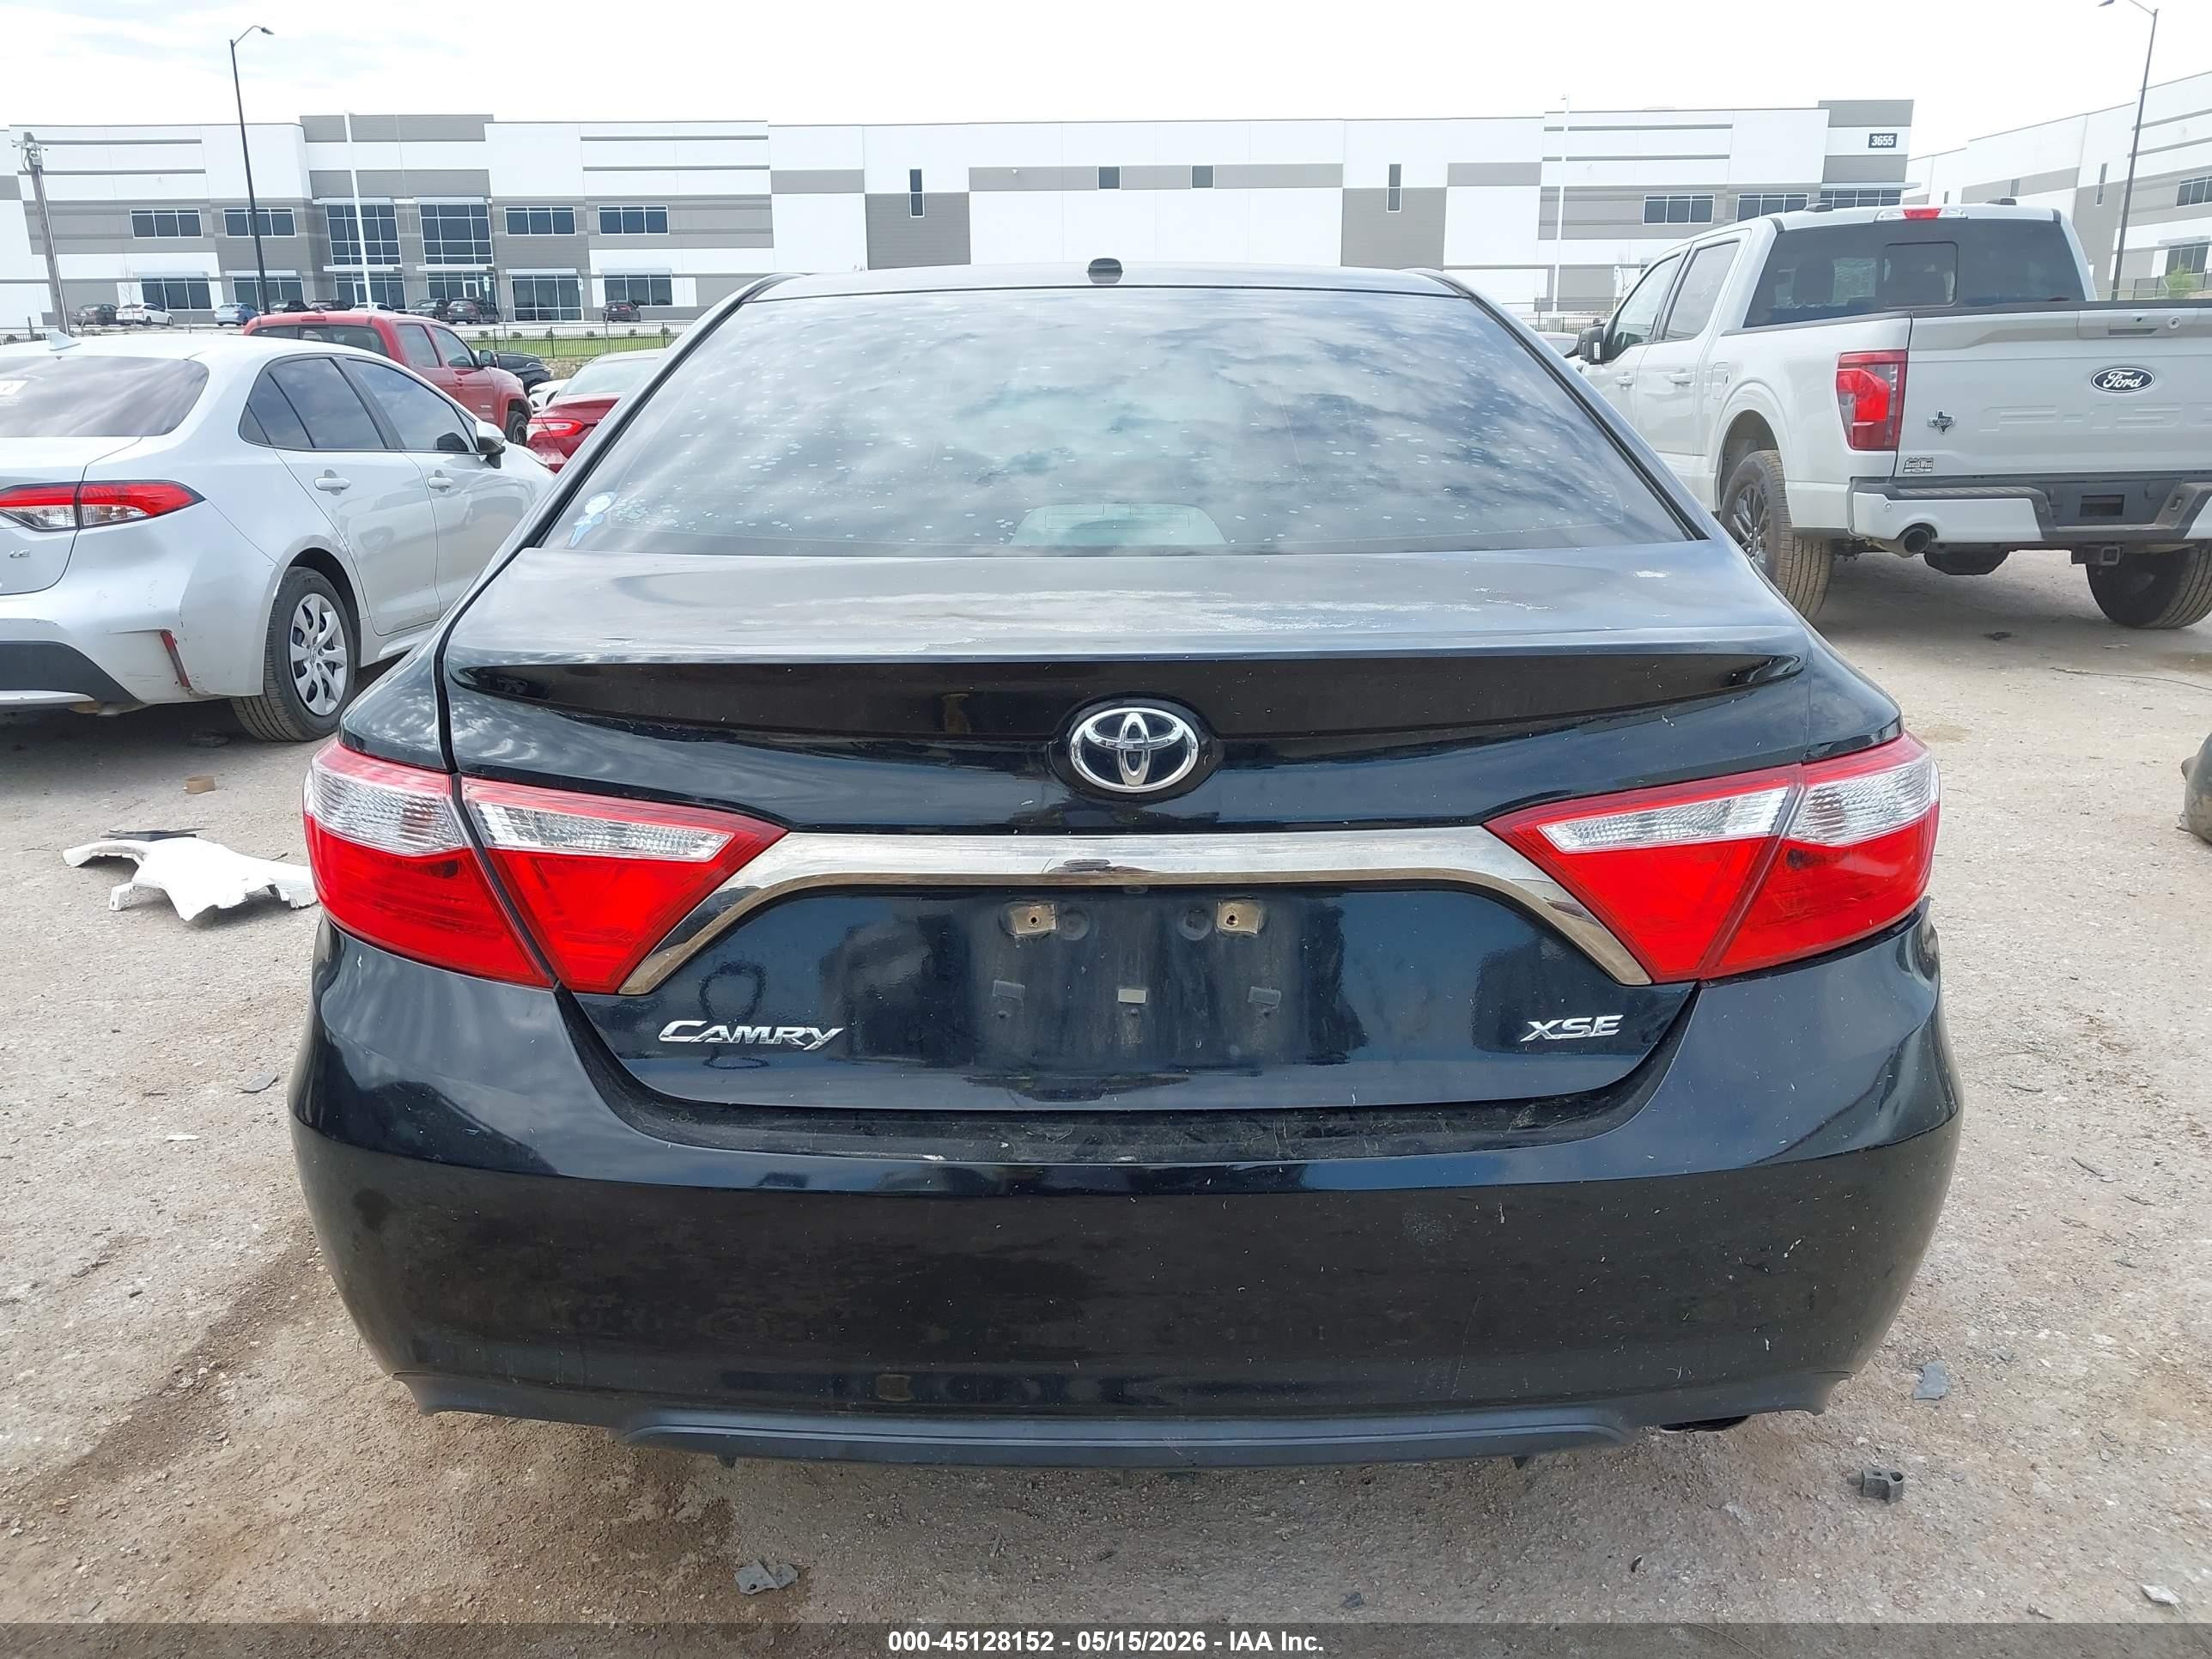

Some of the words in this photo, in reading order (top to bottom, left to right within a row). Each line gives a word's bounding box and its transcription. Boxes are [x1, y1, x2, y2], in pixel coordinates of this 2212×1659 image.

[1871, 135, 1894, 146] 3655
[2102, 370, 2144, 388] Ford
[659, 1020, 844, 1051] CAMRY
[1519, 1014, 1625, 1042] XSE
